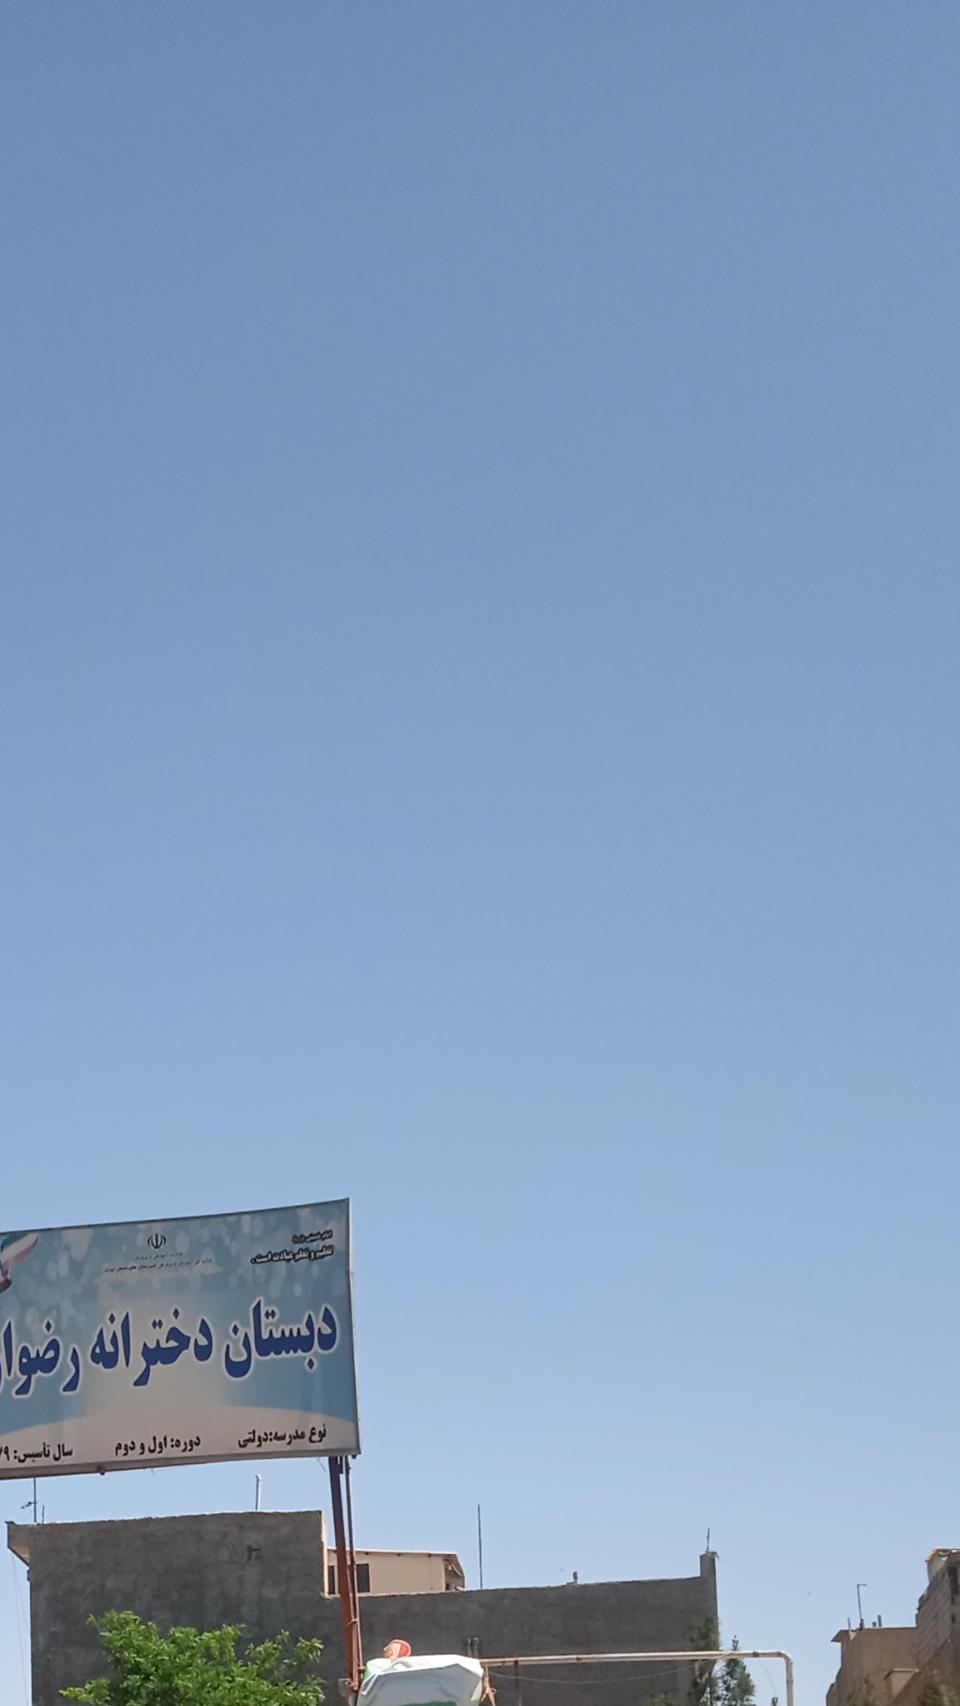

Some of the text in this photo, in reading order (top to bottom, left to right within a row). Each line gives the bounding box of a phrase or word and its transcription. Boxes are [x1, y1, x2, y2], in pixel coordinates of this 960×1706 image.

[90, 1308, 214, 1387] دخترانه
[224, 1298, 338, 1378] دبستان
[308, 1423, 328, 1444] نوع
[53, 1443, 73, 1462] سال
[115, 1435, 201, 1456] دوره: اول و دوم
